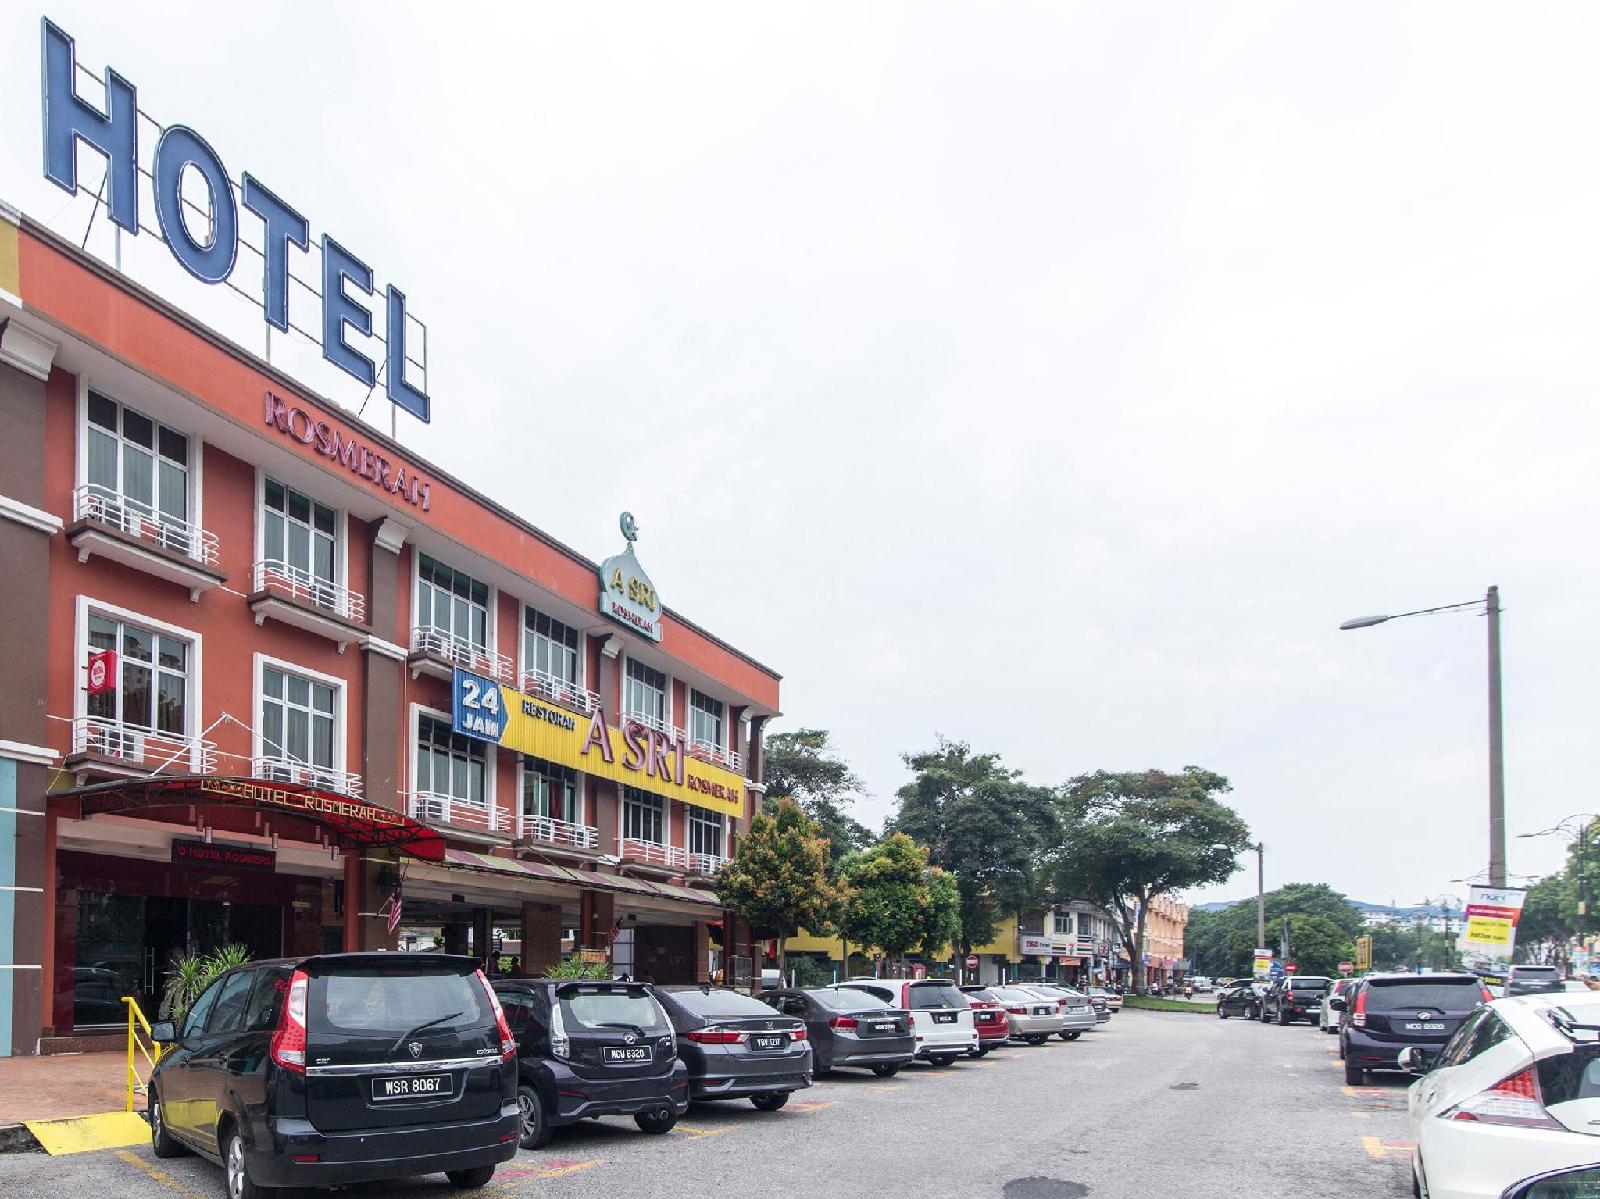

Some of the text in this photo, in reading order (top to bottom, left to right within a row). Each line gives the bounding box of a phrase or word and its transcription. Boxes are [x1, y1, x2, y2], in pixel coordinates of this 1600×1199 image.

[41, 15, 430, 424] HOTEL
[264, 390, 431, 512] ROSMERAH
[610, 567, 656, 612] A SRI
[462, 679, 500, 715] 24
[462, 713, 499, 737] JAM
[521, 699, 740, 805] RESTORAN A SRI ROSMERAH
[243, 782, 377, 821] HOTEL ROSMERAH
[385, 1078, 441, 1095] WSR 8067
